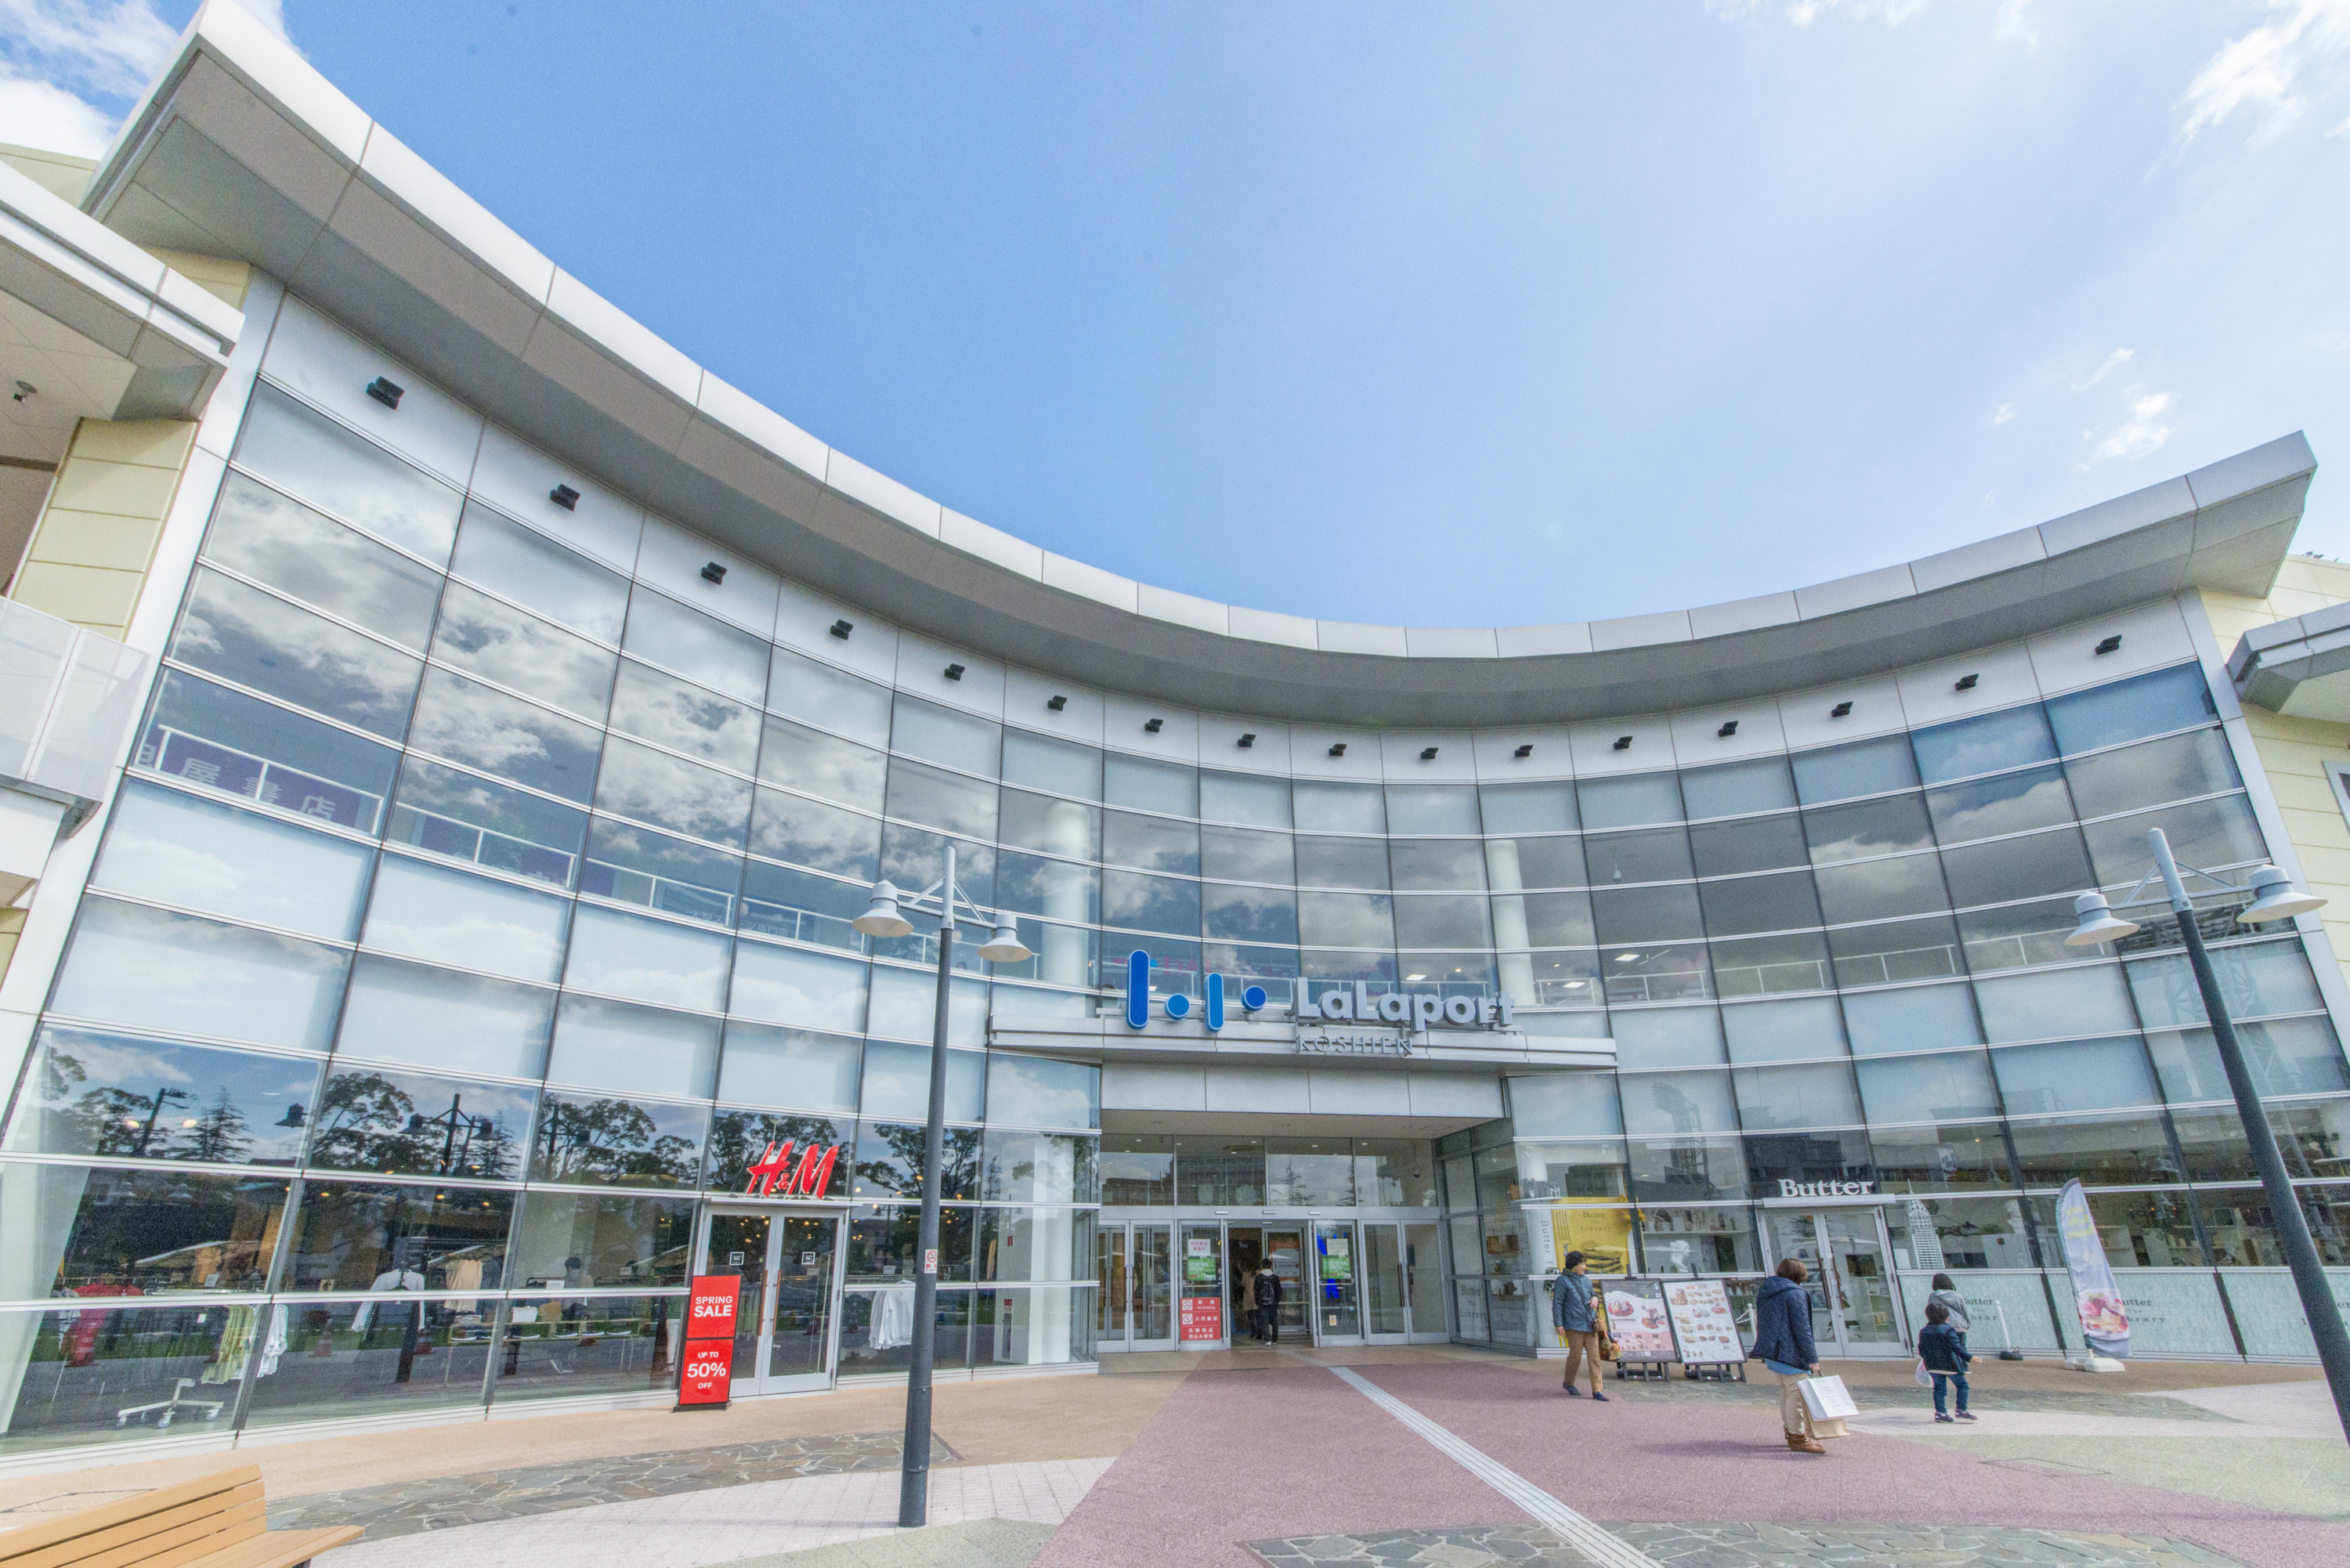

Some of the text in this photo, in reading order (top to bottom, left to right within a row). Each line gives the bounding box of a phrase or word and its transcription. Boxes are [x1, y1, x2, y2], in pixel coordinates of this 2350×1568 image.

[1296, 977, 1515, 1032] LaLaport
[1296, 1035, 1412, 1055] KOSHIEN
[747, 1140, 840, 1200] H&M
[1777, 1179, 1874, 1198] Butter
[1541, 1220, 1550, 1254] Butter
[696, 1295, 732, 1305] SPRING
[1461, 1285, 1481, 1296] Butter
[694, 1305, 732, 1317] SALE
[687, 1362, 726, 1378] 50%
